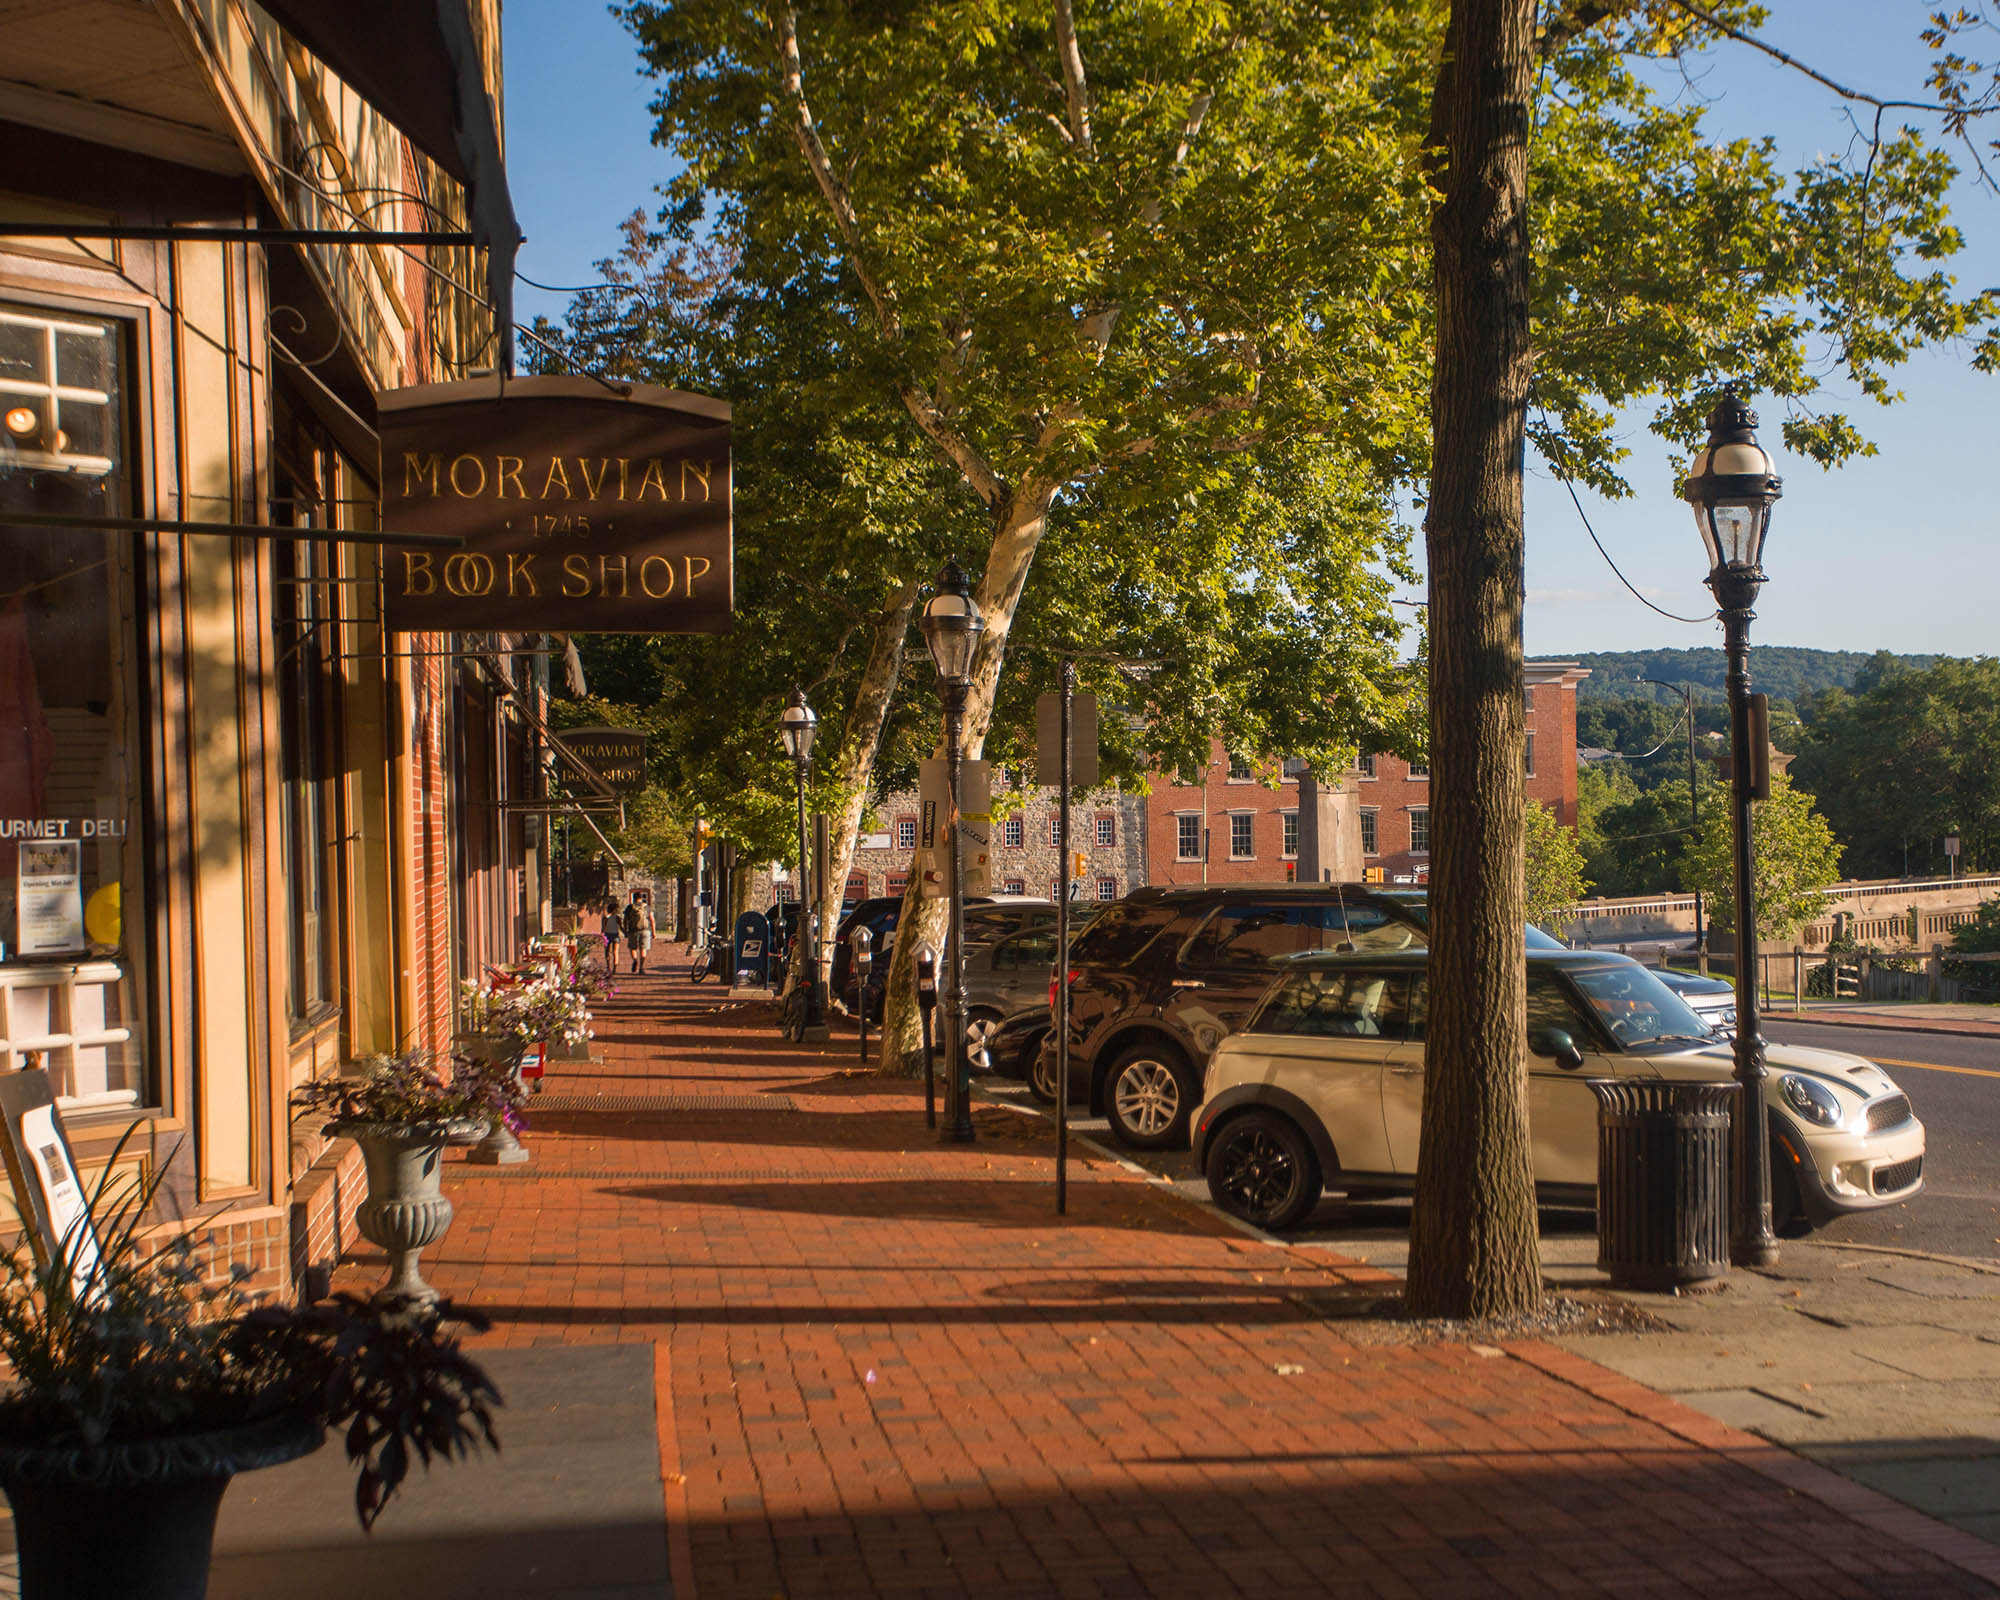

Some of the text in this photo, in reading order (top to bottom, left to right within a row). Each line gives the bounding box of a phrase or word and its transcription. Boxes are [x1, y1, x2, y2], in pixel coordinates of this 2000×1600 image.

[401, 452, 715, 502] MORAVIAN
[530, 515, 591, 538] 1745
[402, 551, 711, 599] BOOK SHOP
[602, 769, 640, 782] SHOP
[81, 819, 126, 836] DELI
